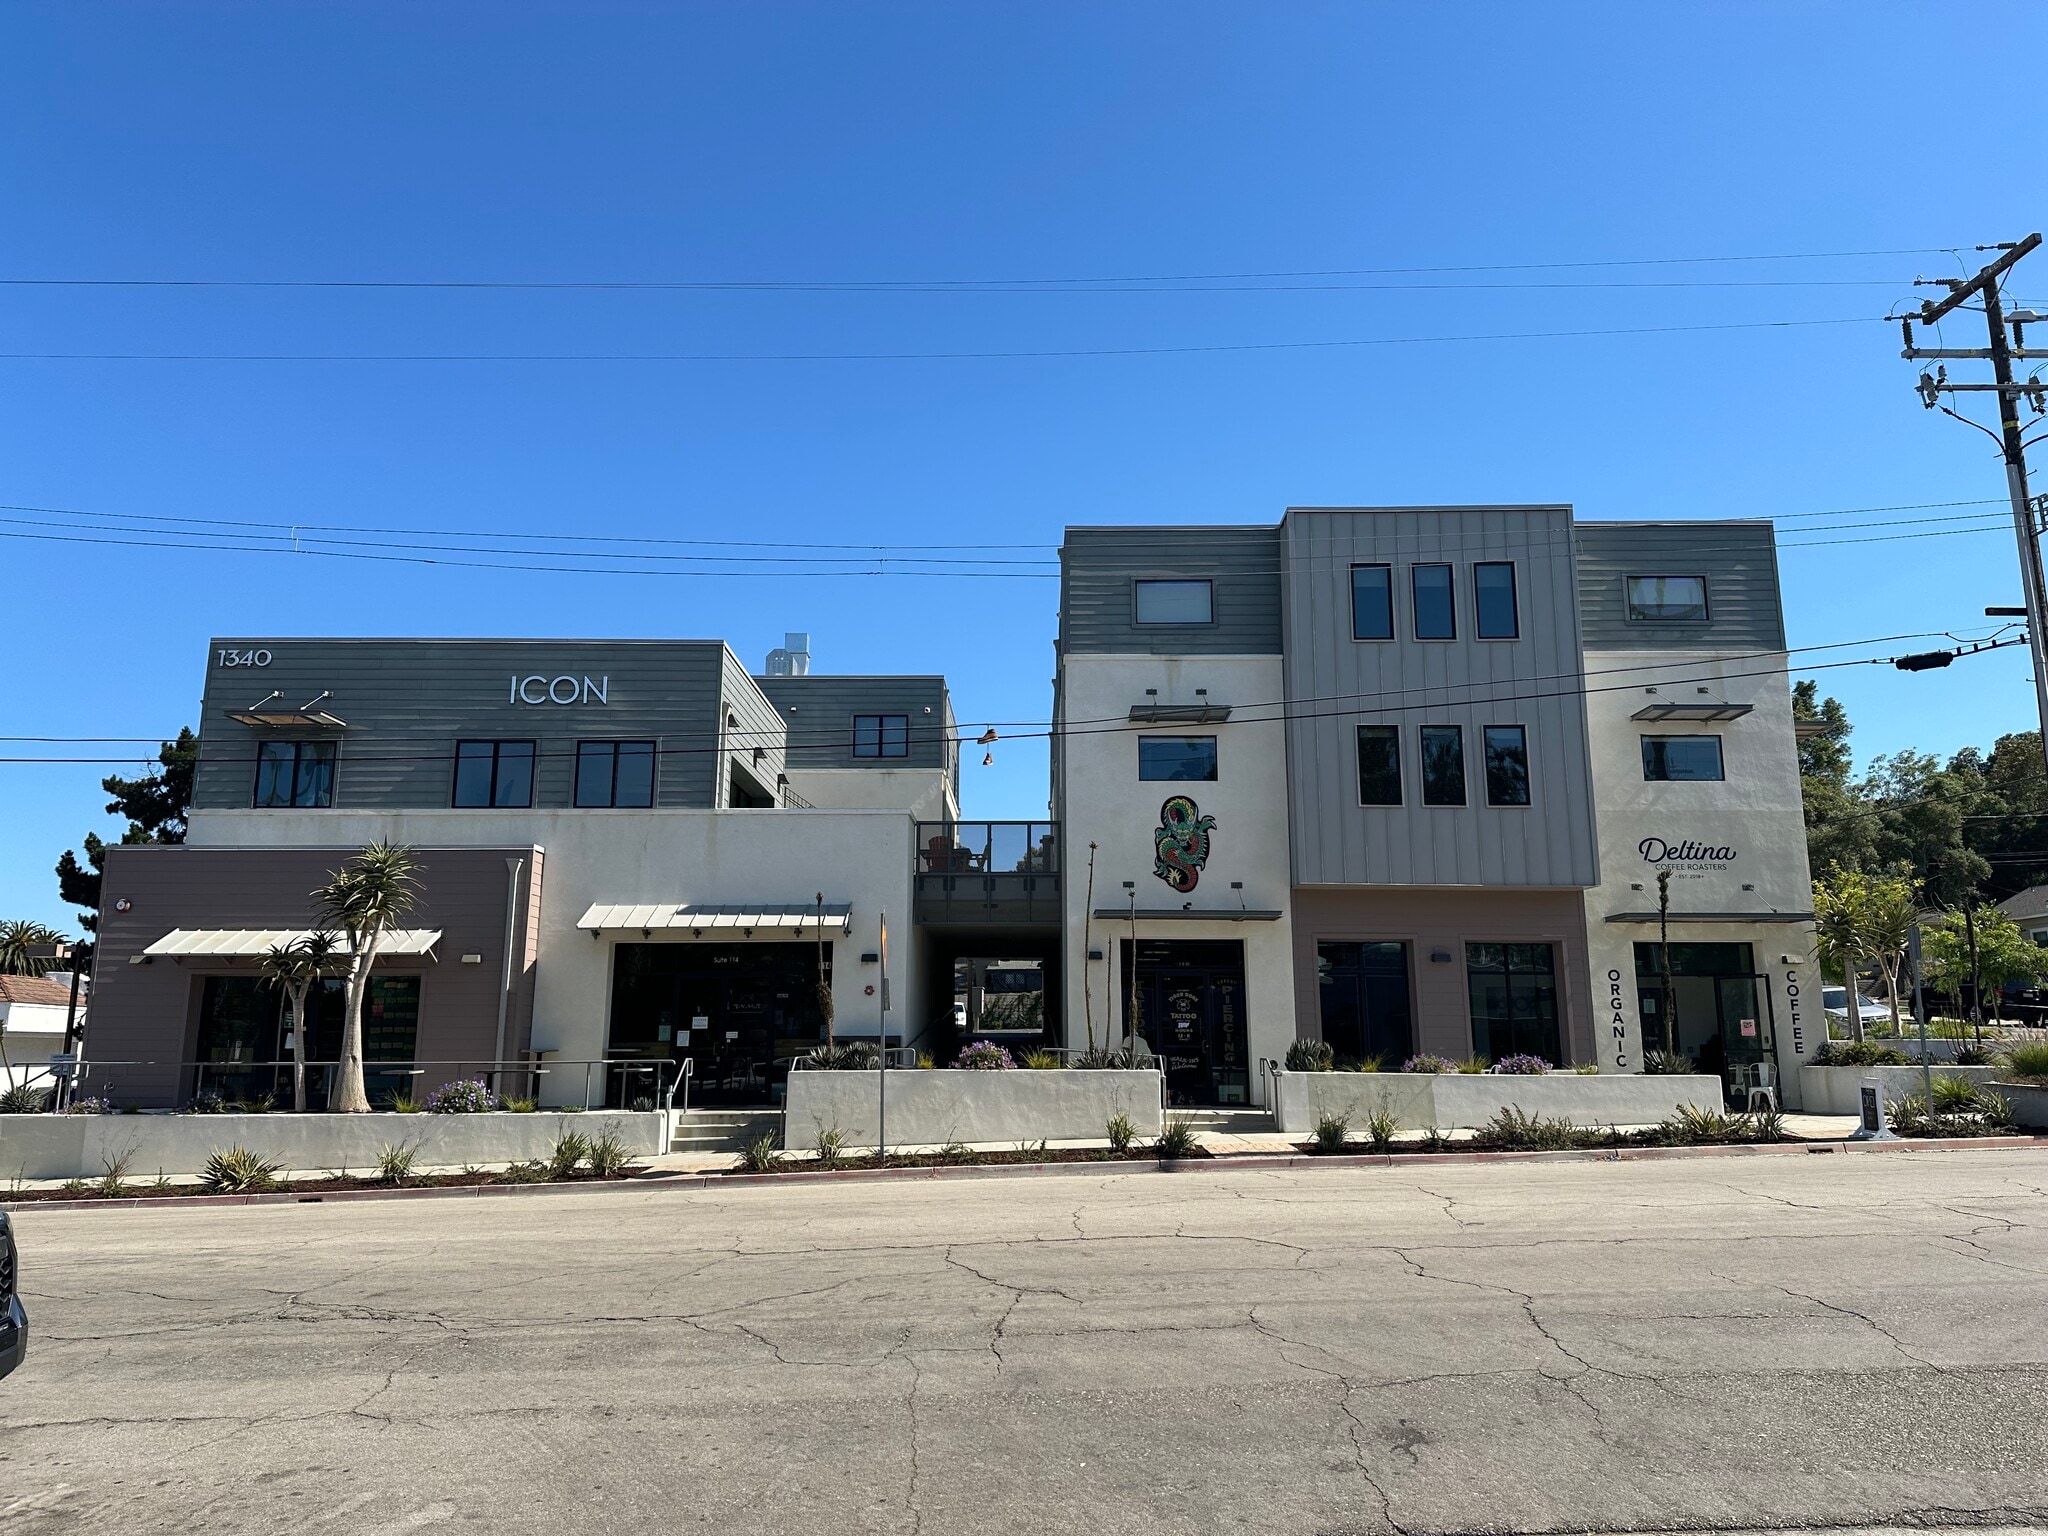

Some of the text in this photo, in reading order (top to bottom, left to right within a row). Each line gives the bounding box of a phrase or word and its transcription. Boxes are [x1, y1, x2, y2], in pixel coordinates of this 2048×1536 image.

[218, 649, 272, 667] 1340
[509, 675, 608, 704] ICON
[1638, 837, 1737, 863] Deltina
[1655, 863, 1727, 871] COFFEE ROASTERS
[713, 956, 739, 964] Suite 114
[1168, 992, 1184, 1002] TIGER
[1221, 985, 1236, 1062] PIERCING
[1607, 969, 1628, 1068] ORGANIC
[1786, 970, 1804, 1054] COFFEE
